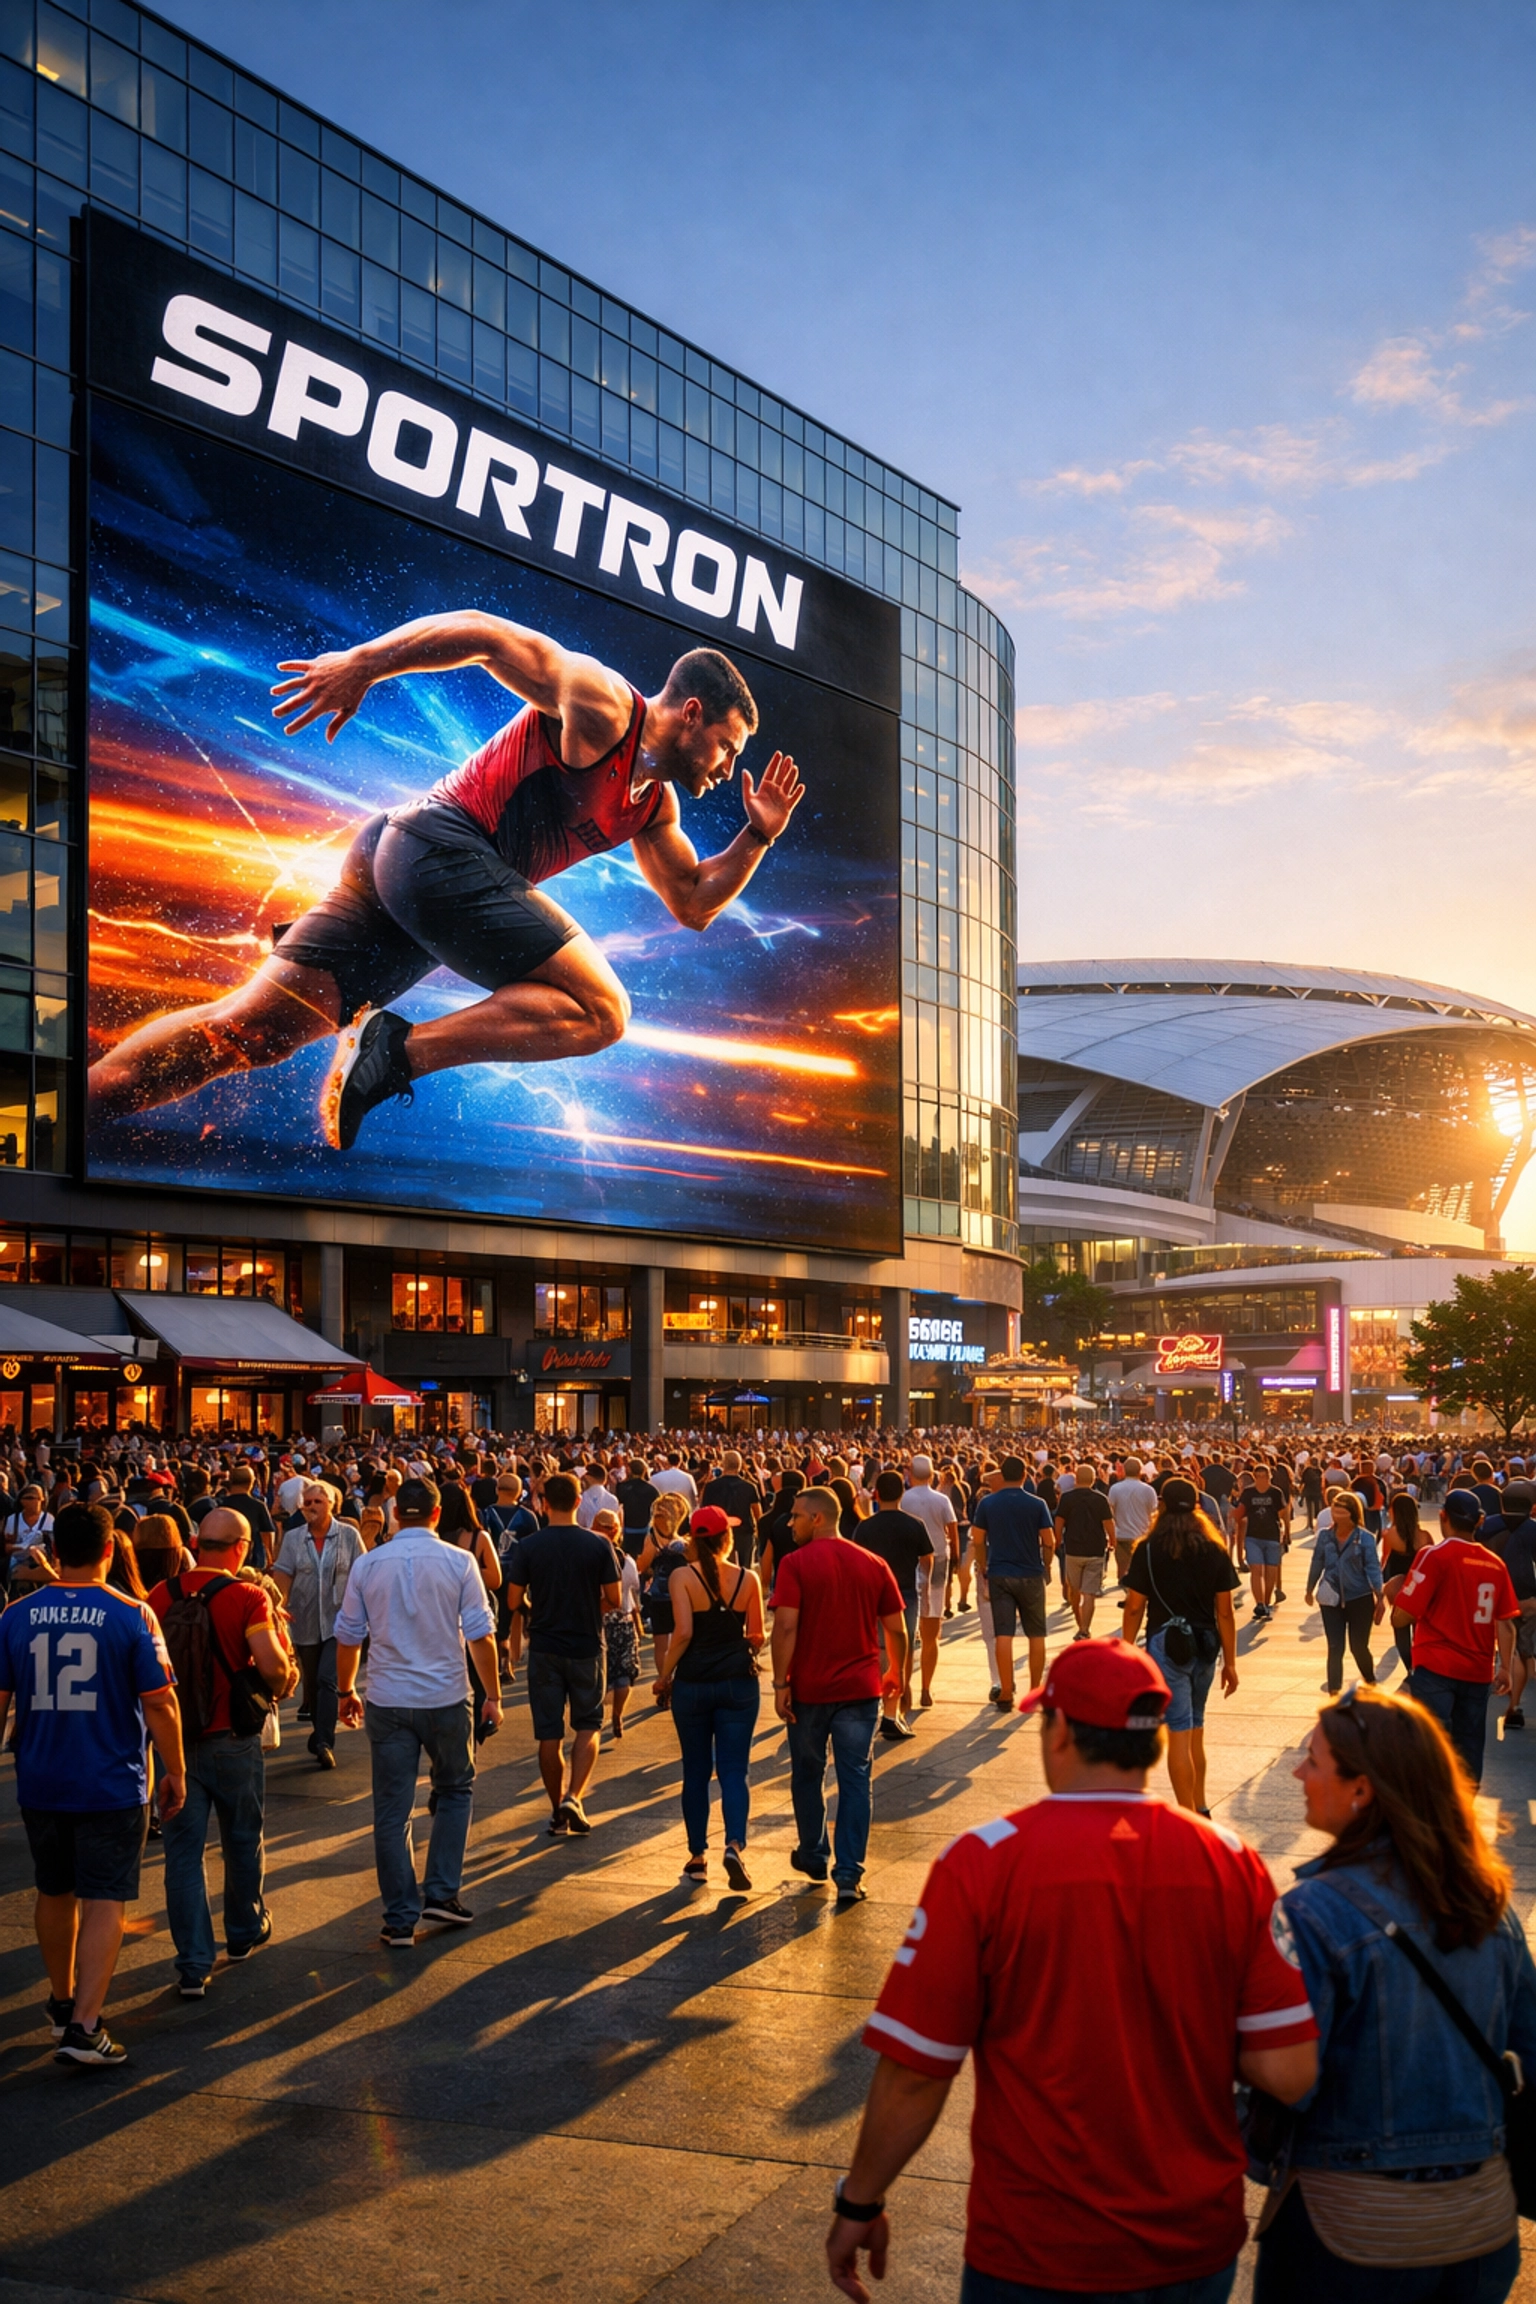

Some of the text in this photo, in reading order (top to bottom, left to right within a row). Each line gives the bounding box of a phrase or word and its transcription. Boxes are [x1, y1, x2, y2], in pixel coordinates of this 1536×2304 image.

[150, 294, 805, 651] SPORTRON
[1473, 1582, 1495, 1624] 9
[29, 1632, 98, 1711] 12
